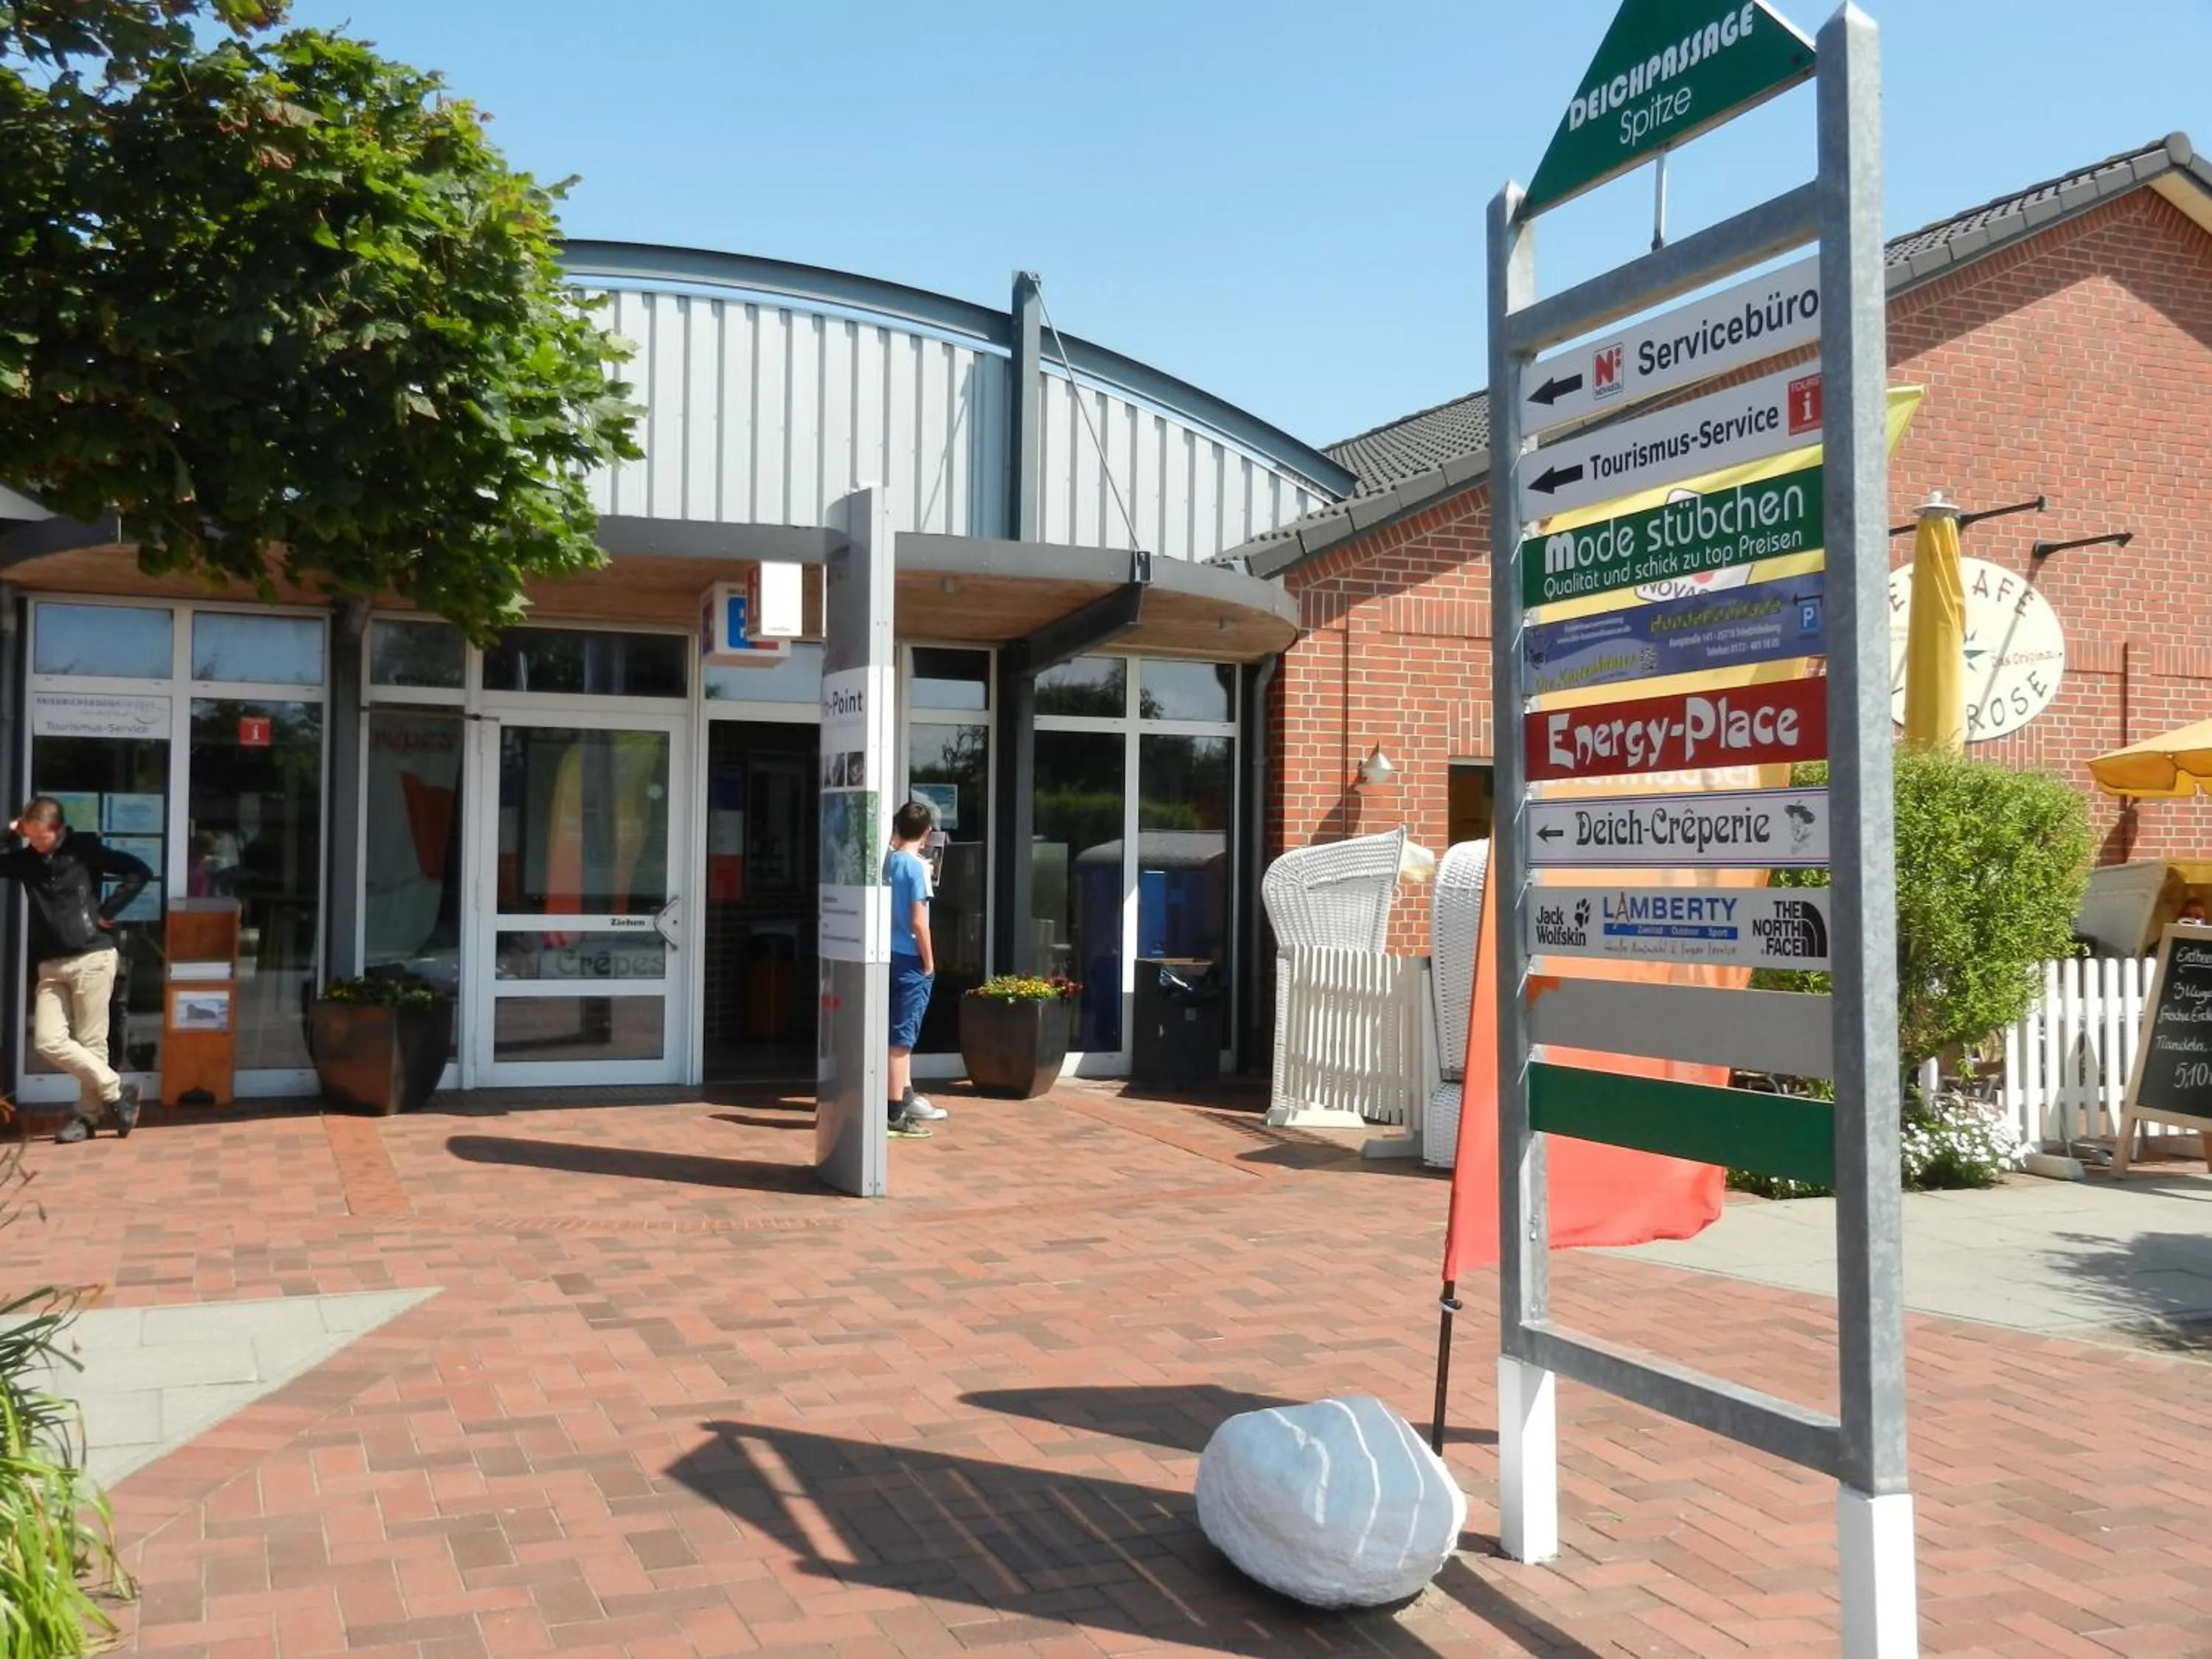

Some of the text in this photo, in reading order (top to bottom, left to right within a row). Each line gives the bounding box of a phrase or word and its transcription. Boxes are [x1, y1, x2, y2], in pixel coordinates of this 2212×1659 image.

[1568, 3, 1755, 132] DEICHPASSAGE
[1619, 85, 1692, 147] Spitze
[1637, 288, 1820, 376] Servicebüro
[1590, 406, 1779, 480] Tourismus-Service
[1646, 484, 1805, 552] stübchen
[1543, 529, 1802, 599] Qualität und schick zu top Preisen
[1803, 606, 1815, 627] P
[1548, 696, 1800, 771] Energy-Place
[1576, 803, 1770, 853] Deich-Crêperie
[1536, 905, 1565, 926] Jack
[1603, 891, 1737, 923] LAMBERTY
[1773, 900, 1800, 919] THE
[1536, 924, 1587, 947] Wolfskin
[1753, 919, 1801, 937] NORTH
[1766, 937, 1800, 956] FACE
[556, 950, 665, 977] Crêpes
